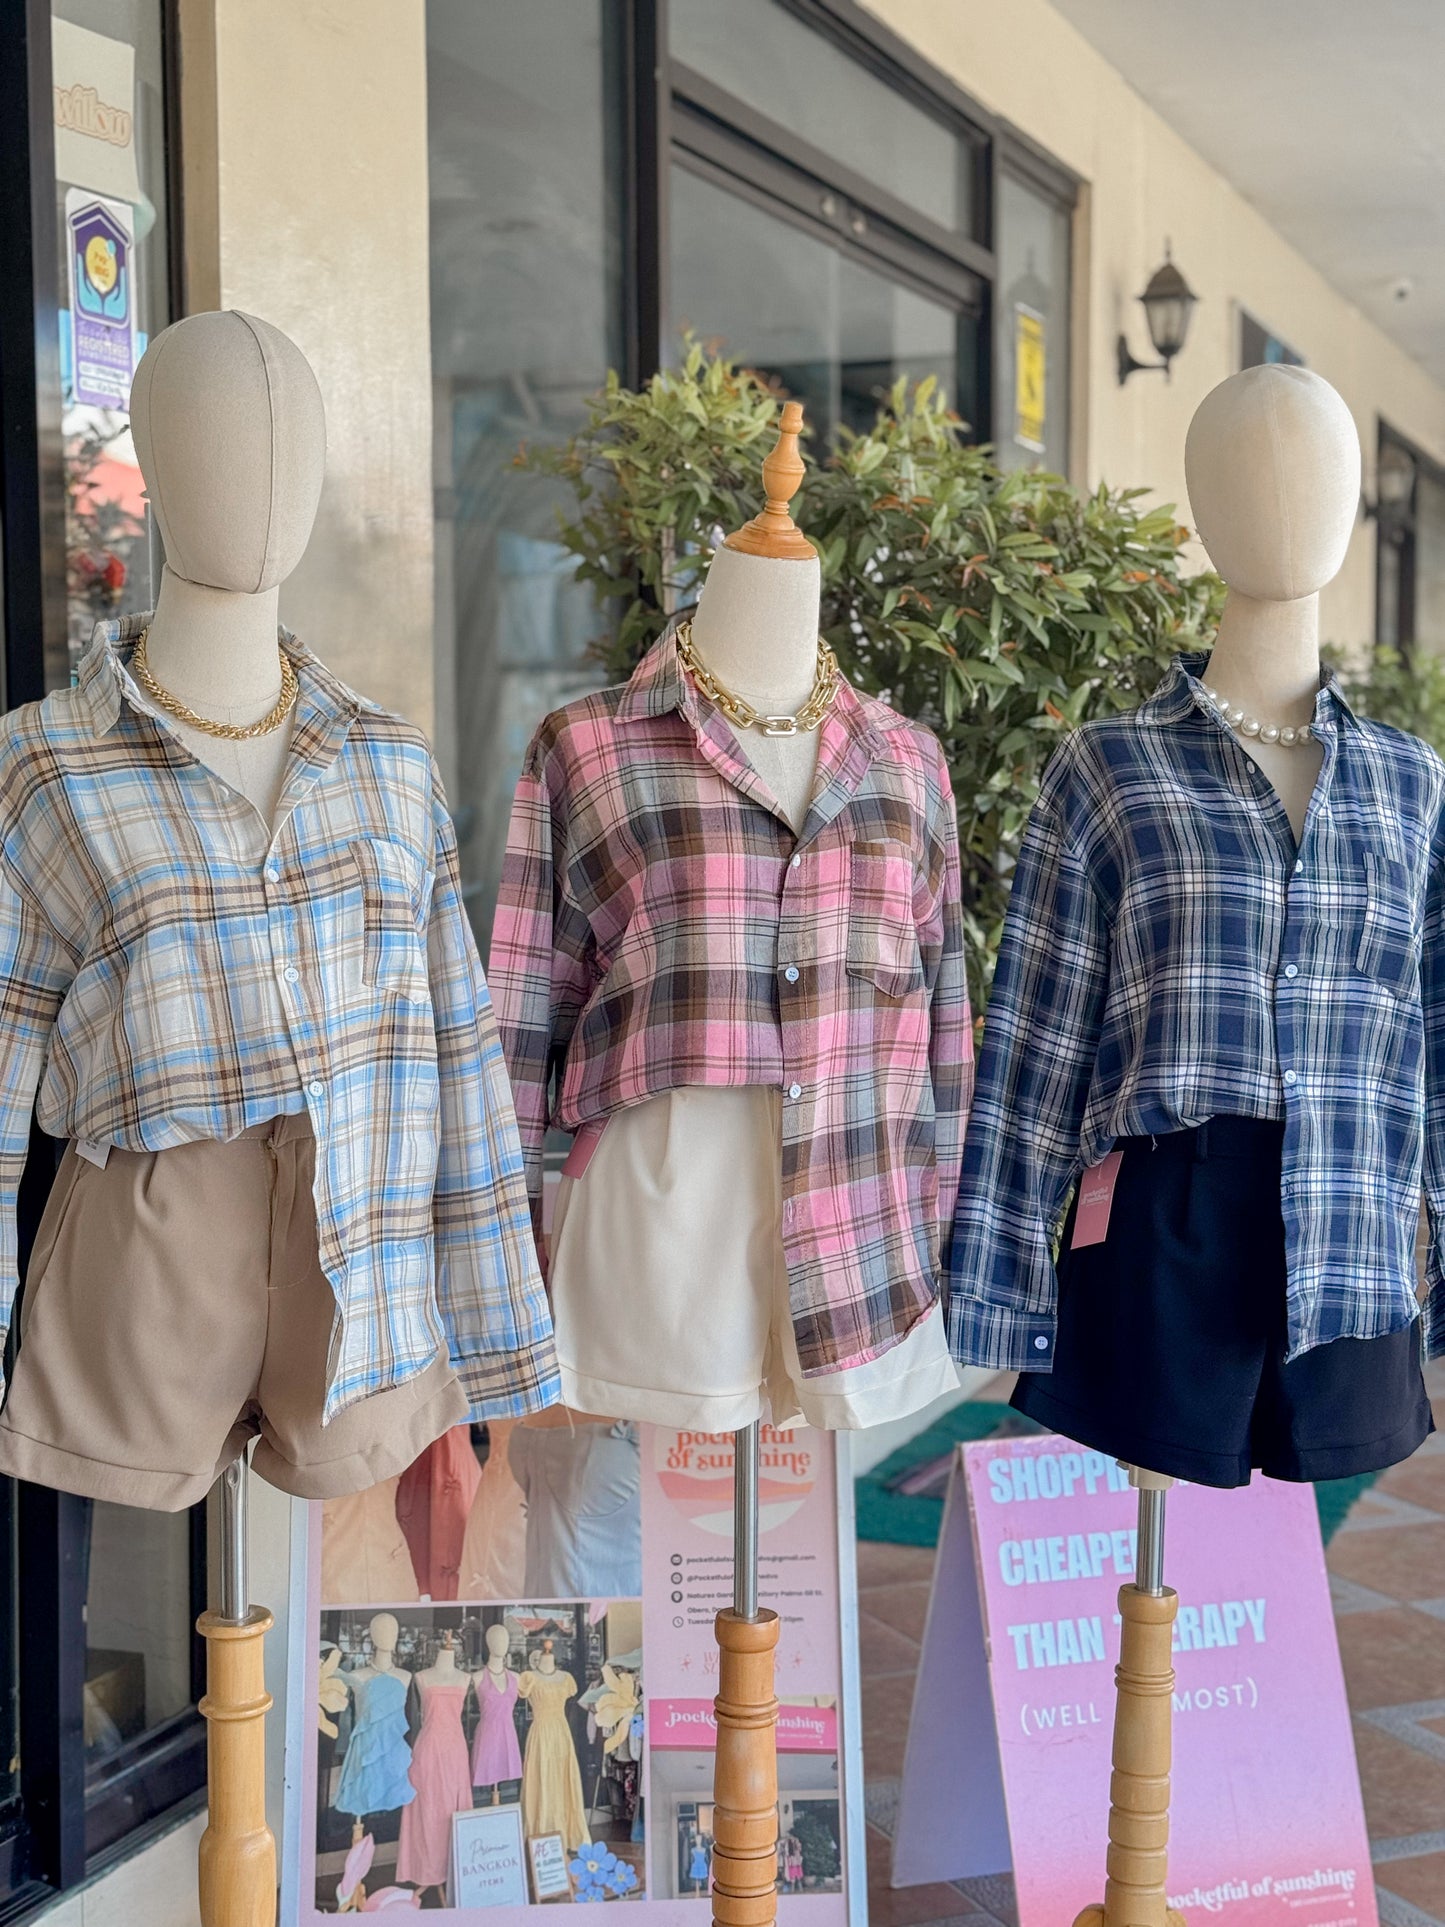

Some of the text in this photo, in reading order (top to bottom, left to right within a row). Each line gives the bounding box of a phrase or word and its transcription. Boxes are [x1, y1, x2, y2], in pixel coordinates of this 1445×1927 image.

[667, 1447, 693, 1468] of
[988, 1450, 1130, 1504] SHOPPI
[999, 1529, 1138, 1587] CHEAPE
[1007, 1616, 1106, 1670] THAN
[462, 1857, 519, 1877] BANGKOK
[1251, 1875, 1274, 1898] of
[1273, 1868, 1357, 1893] sunshine
